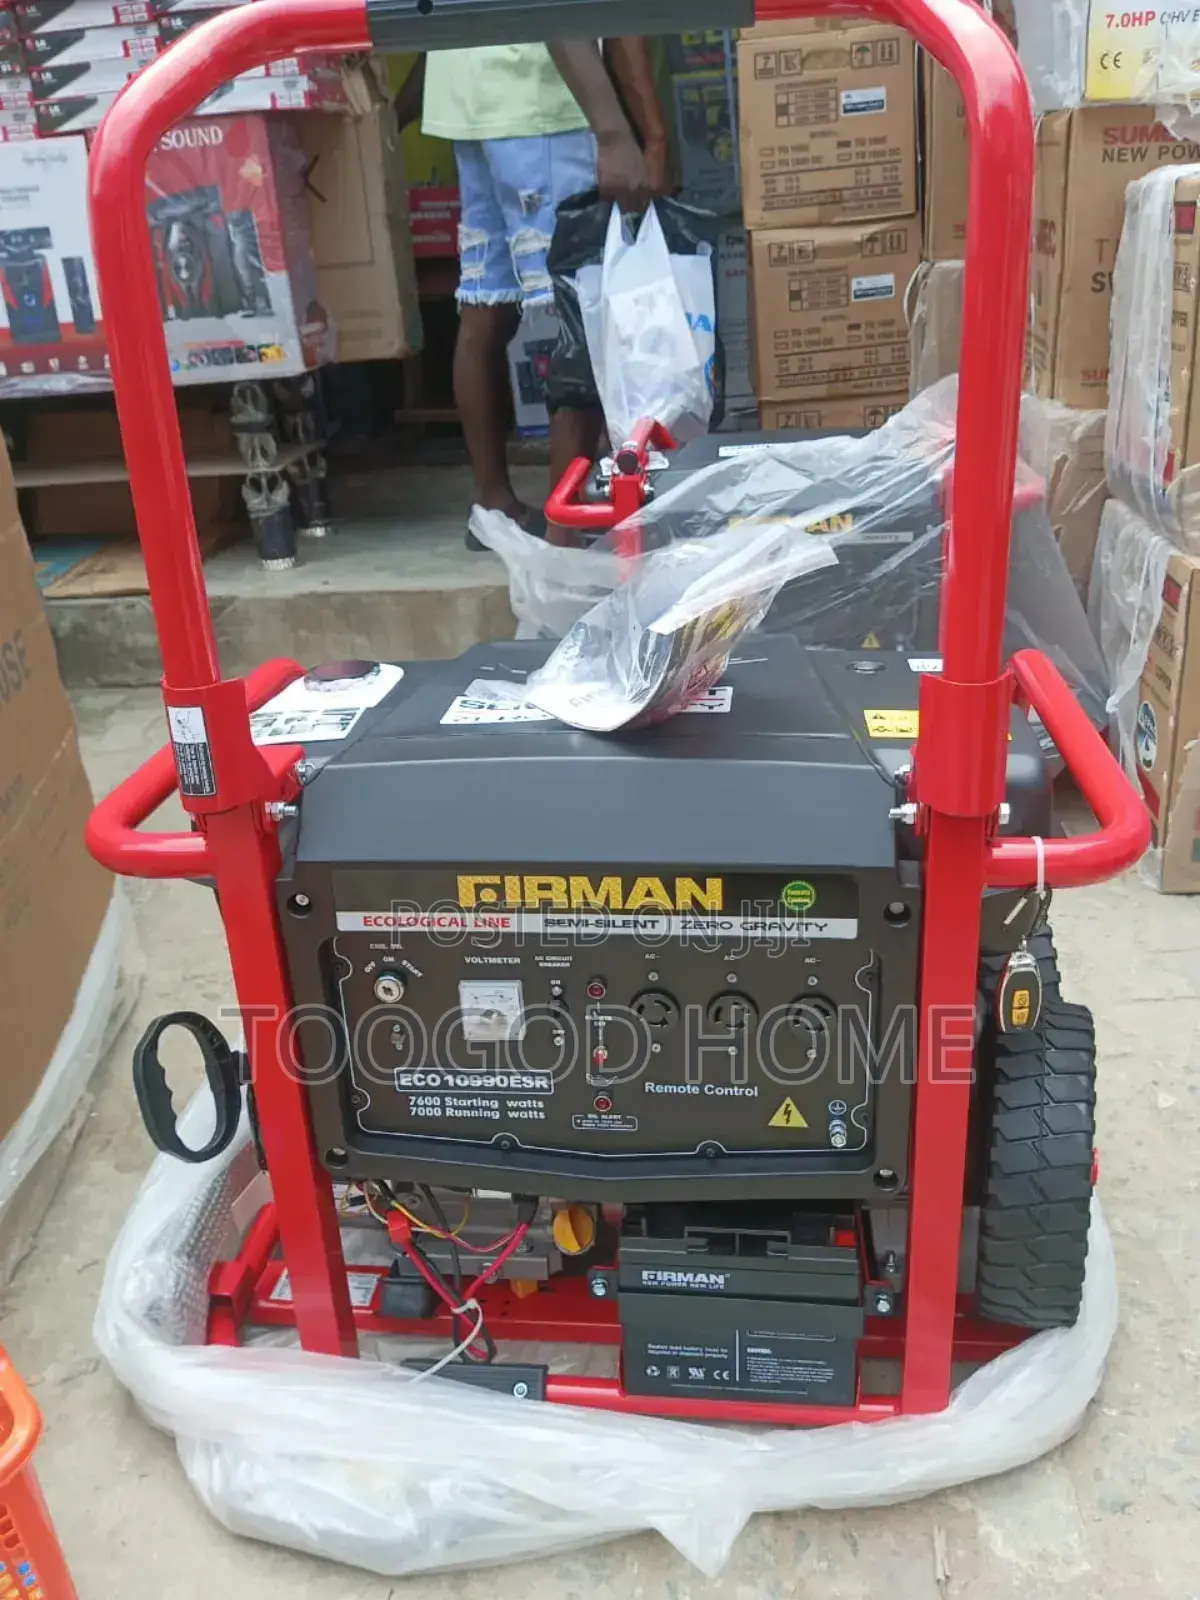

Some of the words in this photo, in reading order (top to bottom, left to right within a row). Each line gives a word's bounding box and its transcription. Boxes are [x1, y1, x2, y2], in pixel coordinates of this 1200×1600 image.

[1105, 10, 1156, 28] 7.0HP
[1100, 51, 1122, 69] CE
[160, 124, 223, 149] SOUND
[1102, 146, 1149, 163] NEW
[456, 875, 723, 911] FIRMAN
[363, 915, 468, 929] ECOLOGICAL
[473, 916, 511, 930] LINE
[544, 917, 660, 931] SEMI-SILENT
[680, 920, 734, 931] ZERO
[739, 921, 829, 933] GRAVITY
[464, 955, 521, 965] VOLTMETER
[644, 1082, 700, 1095] Remote
[704, 1084, 759, 1097] Control
[408, 1096, 441, 1106] 7600
[445, 1096, 499, 1109] Starting
[505, 1099, 545, 1109] watts
[410, 1106, 442, 1117] 7000
[446, 1108, 500, 1119] Running
[506, 1110, 546, 1120] watts
[642, 1270, 725, 1285] FIRMAN
